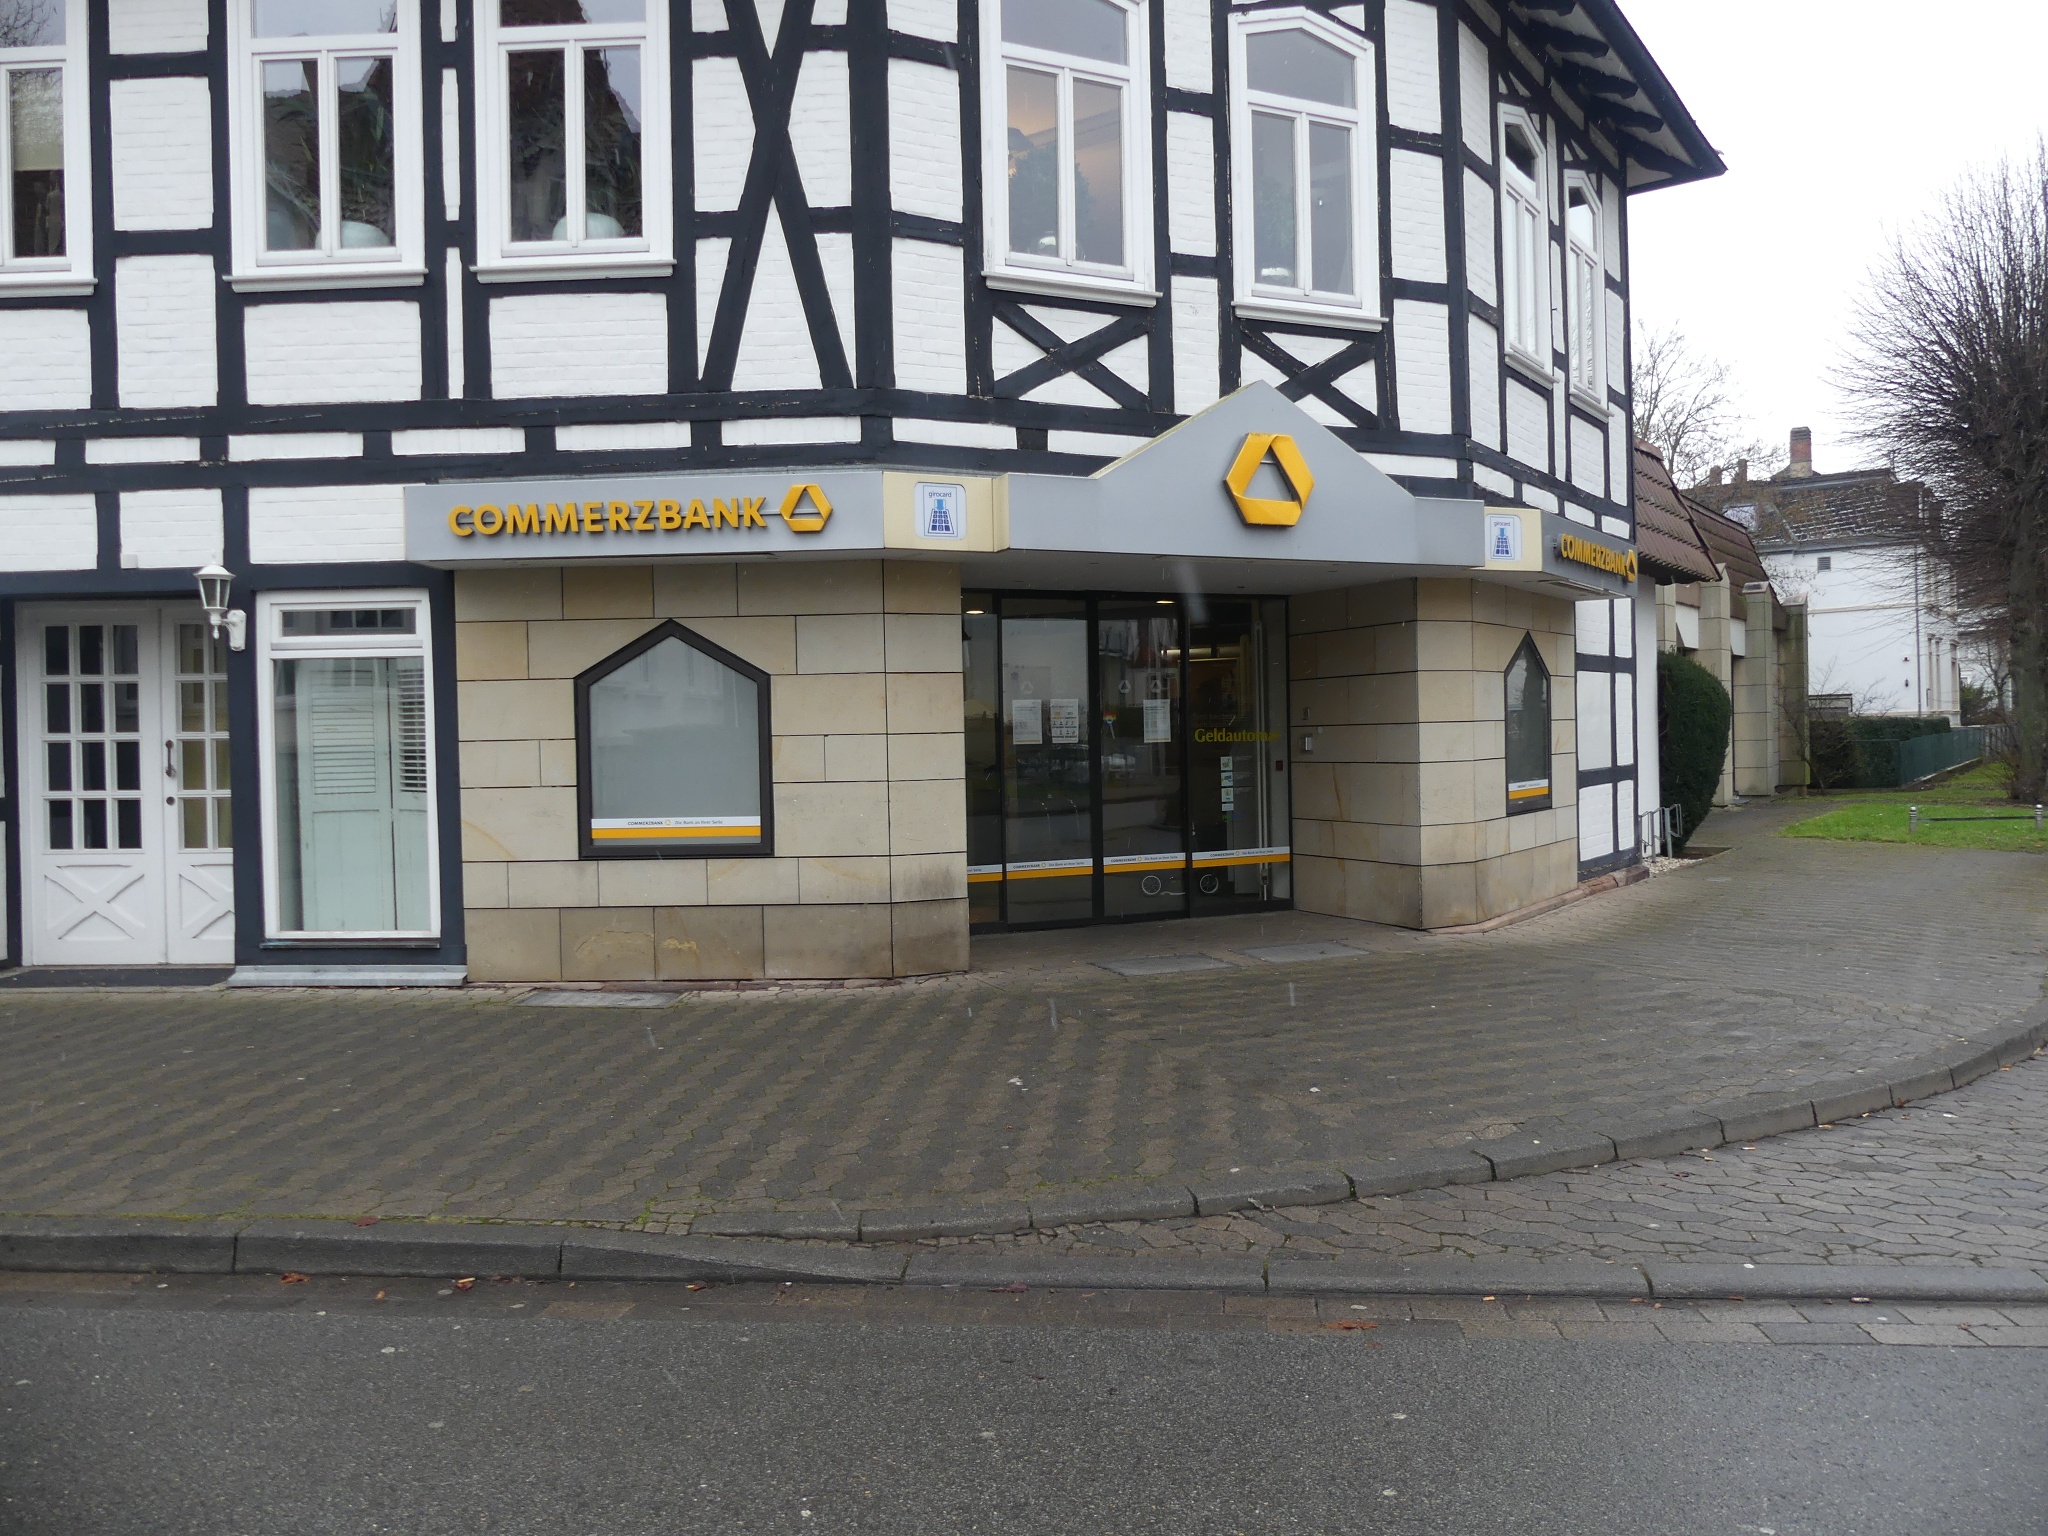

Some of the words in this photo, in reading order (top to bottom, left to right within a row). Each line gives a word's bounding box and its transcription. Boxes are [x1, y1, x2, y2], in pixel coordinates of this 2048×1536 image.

[928, 490, 952, 498] girocard
[448, 496, 767, 537] COMMERZBANK
[1561, 534, 1626, 576] COMMERZBANK
